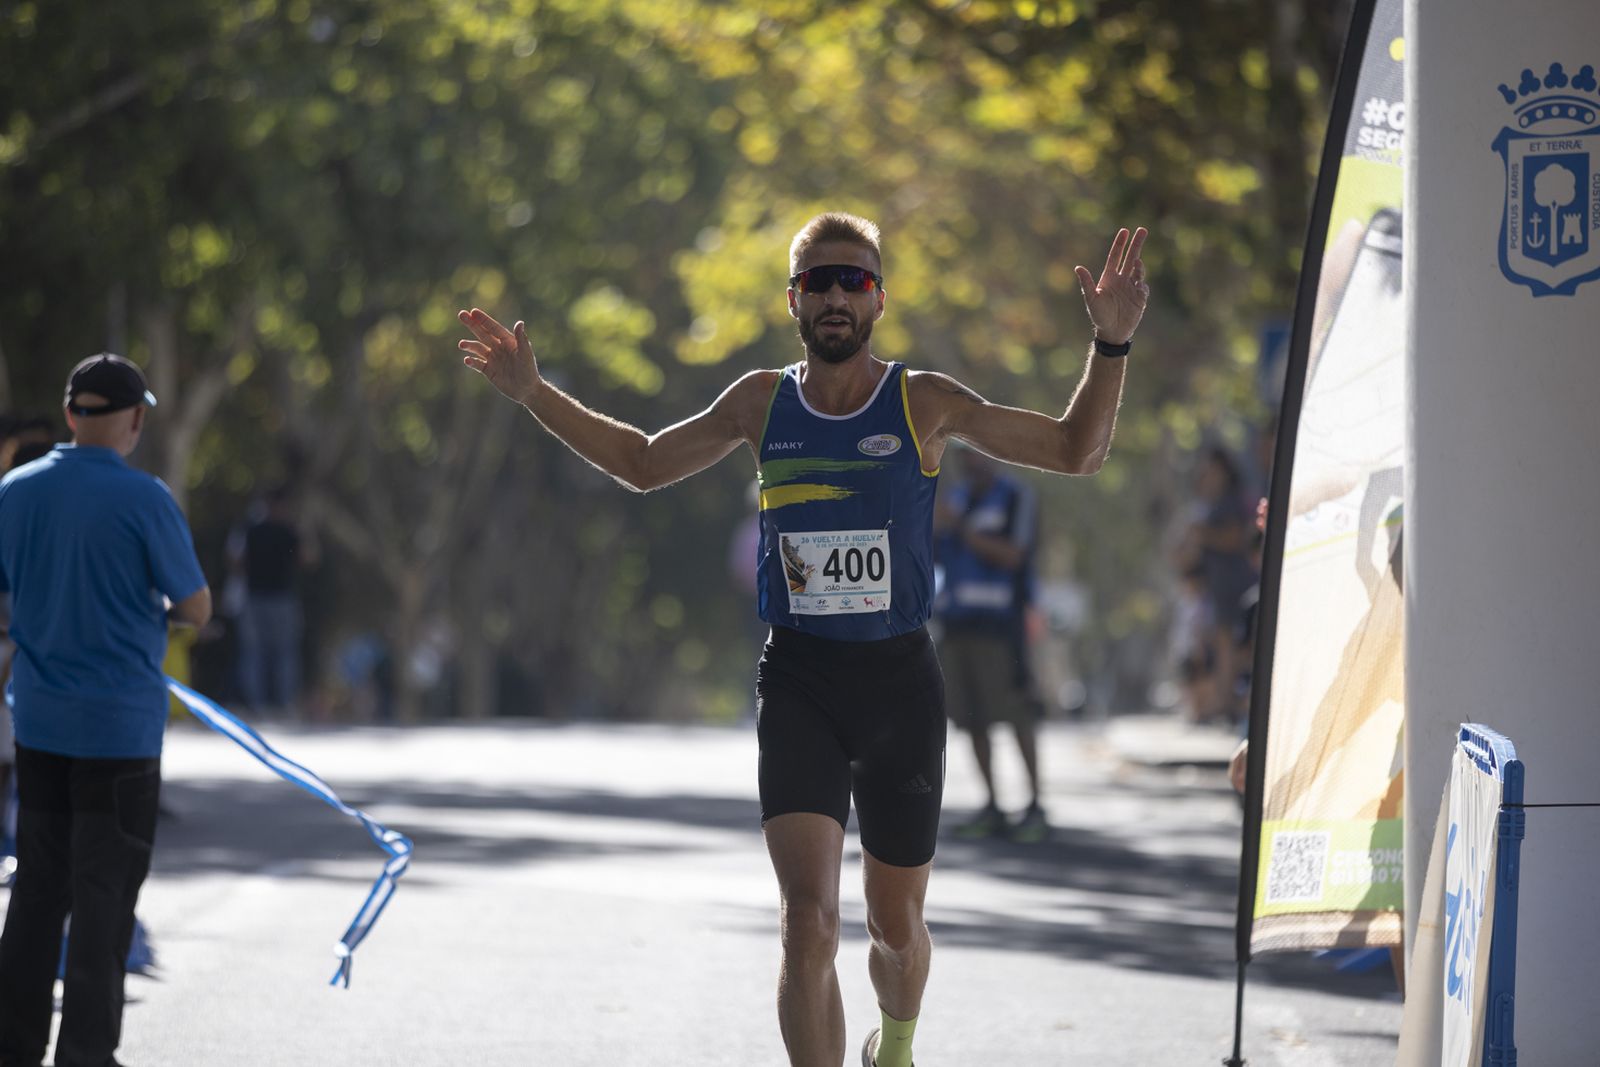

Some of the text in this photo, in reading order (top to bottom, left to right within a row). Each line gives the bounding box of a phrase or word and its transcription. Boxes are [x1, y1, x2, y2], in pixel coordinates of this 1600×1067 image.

[1529, 142, 1541, 152] ET
[1510, 163, 1519, 249] PORTUS MARIS
[1592, 173, 1600, 230] CUSTODIA
[768, 441, 804, 451] ANAKY
[812, 535, 841, 544] VUELTA
[853, 534, 881, 542] HUELVA
[823, 547, 885, 583] 400
[823, 584, 840, 592] JOÃO
